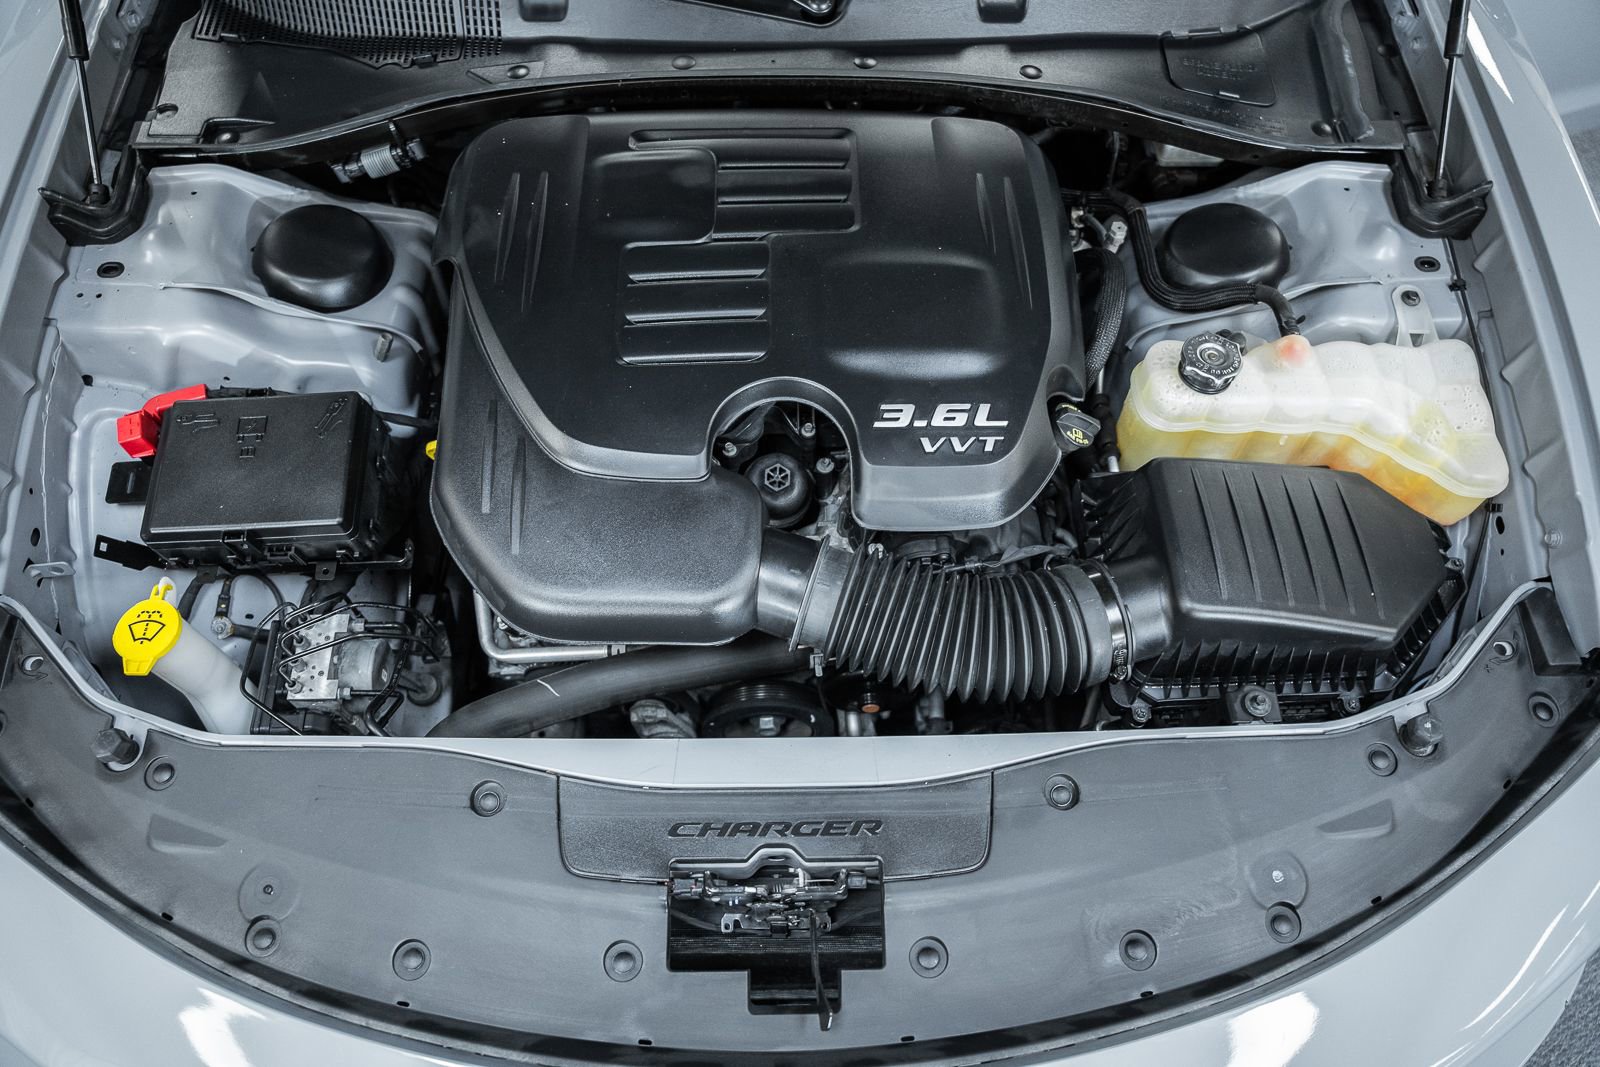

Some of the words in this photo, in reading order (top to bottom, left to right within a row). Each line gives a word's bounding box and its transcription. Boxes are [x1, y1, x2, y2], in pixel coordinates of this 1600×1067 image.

[873, 404, 1008, 428] 3.6L
[919, 437, 1004, 453] VVT
[667, 820, 883, 838] CHARGER
